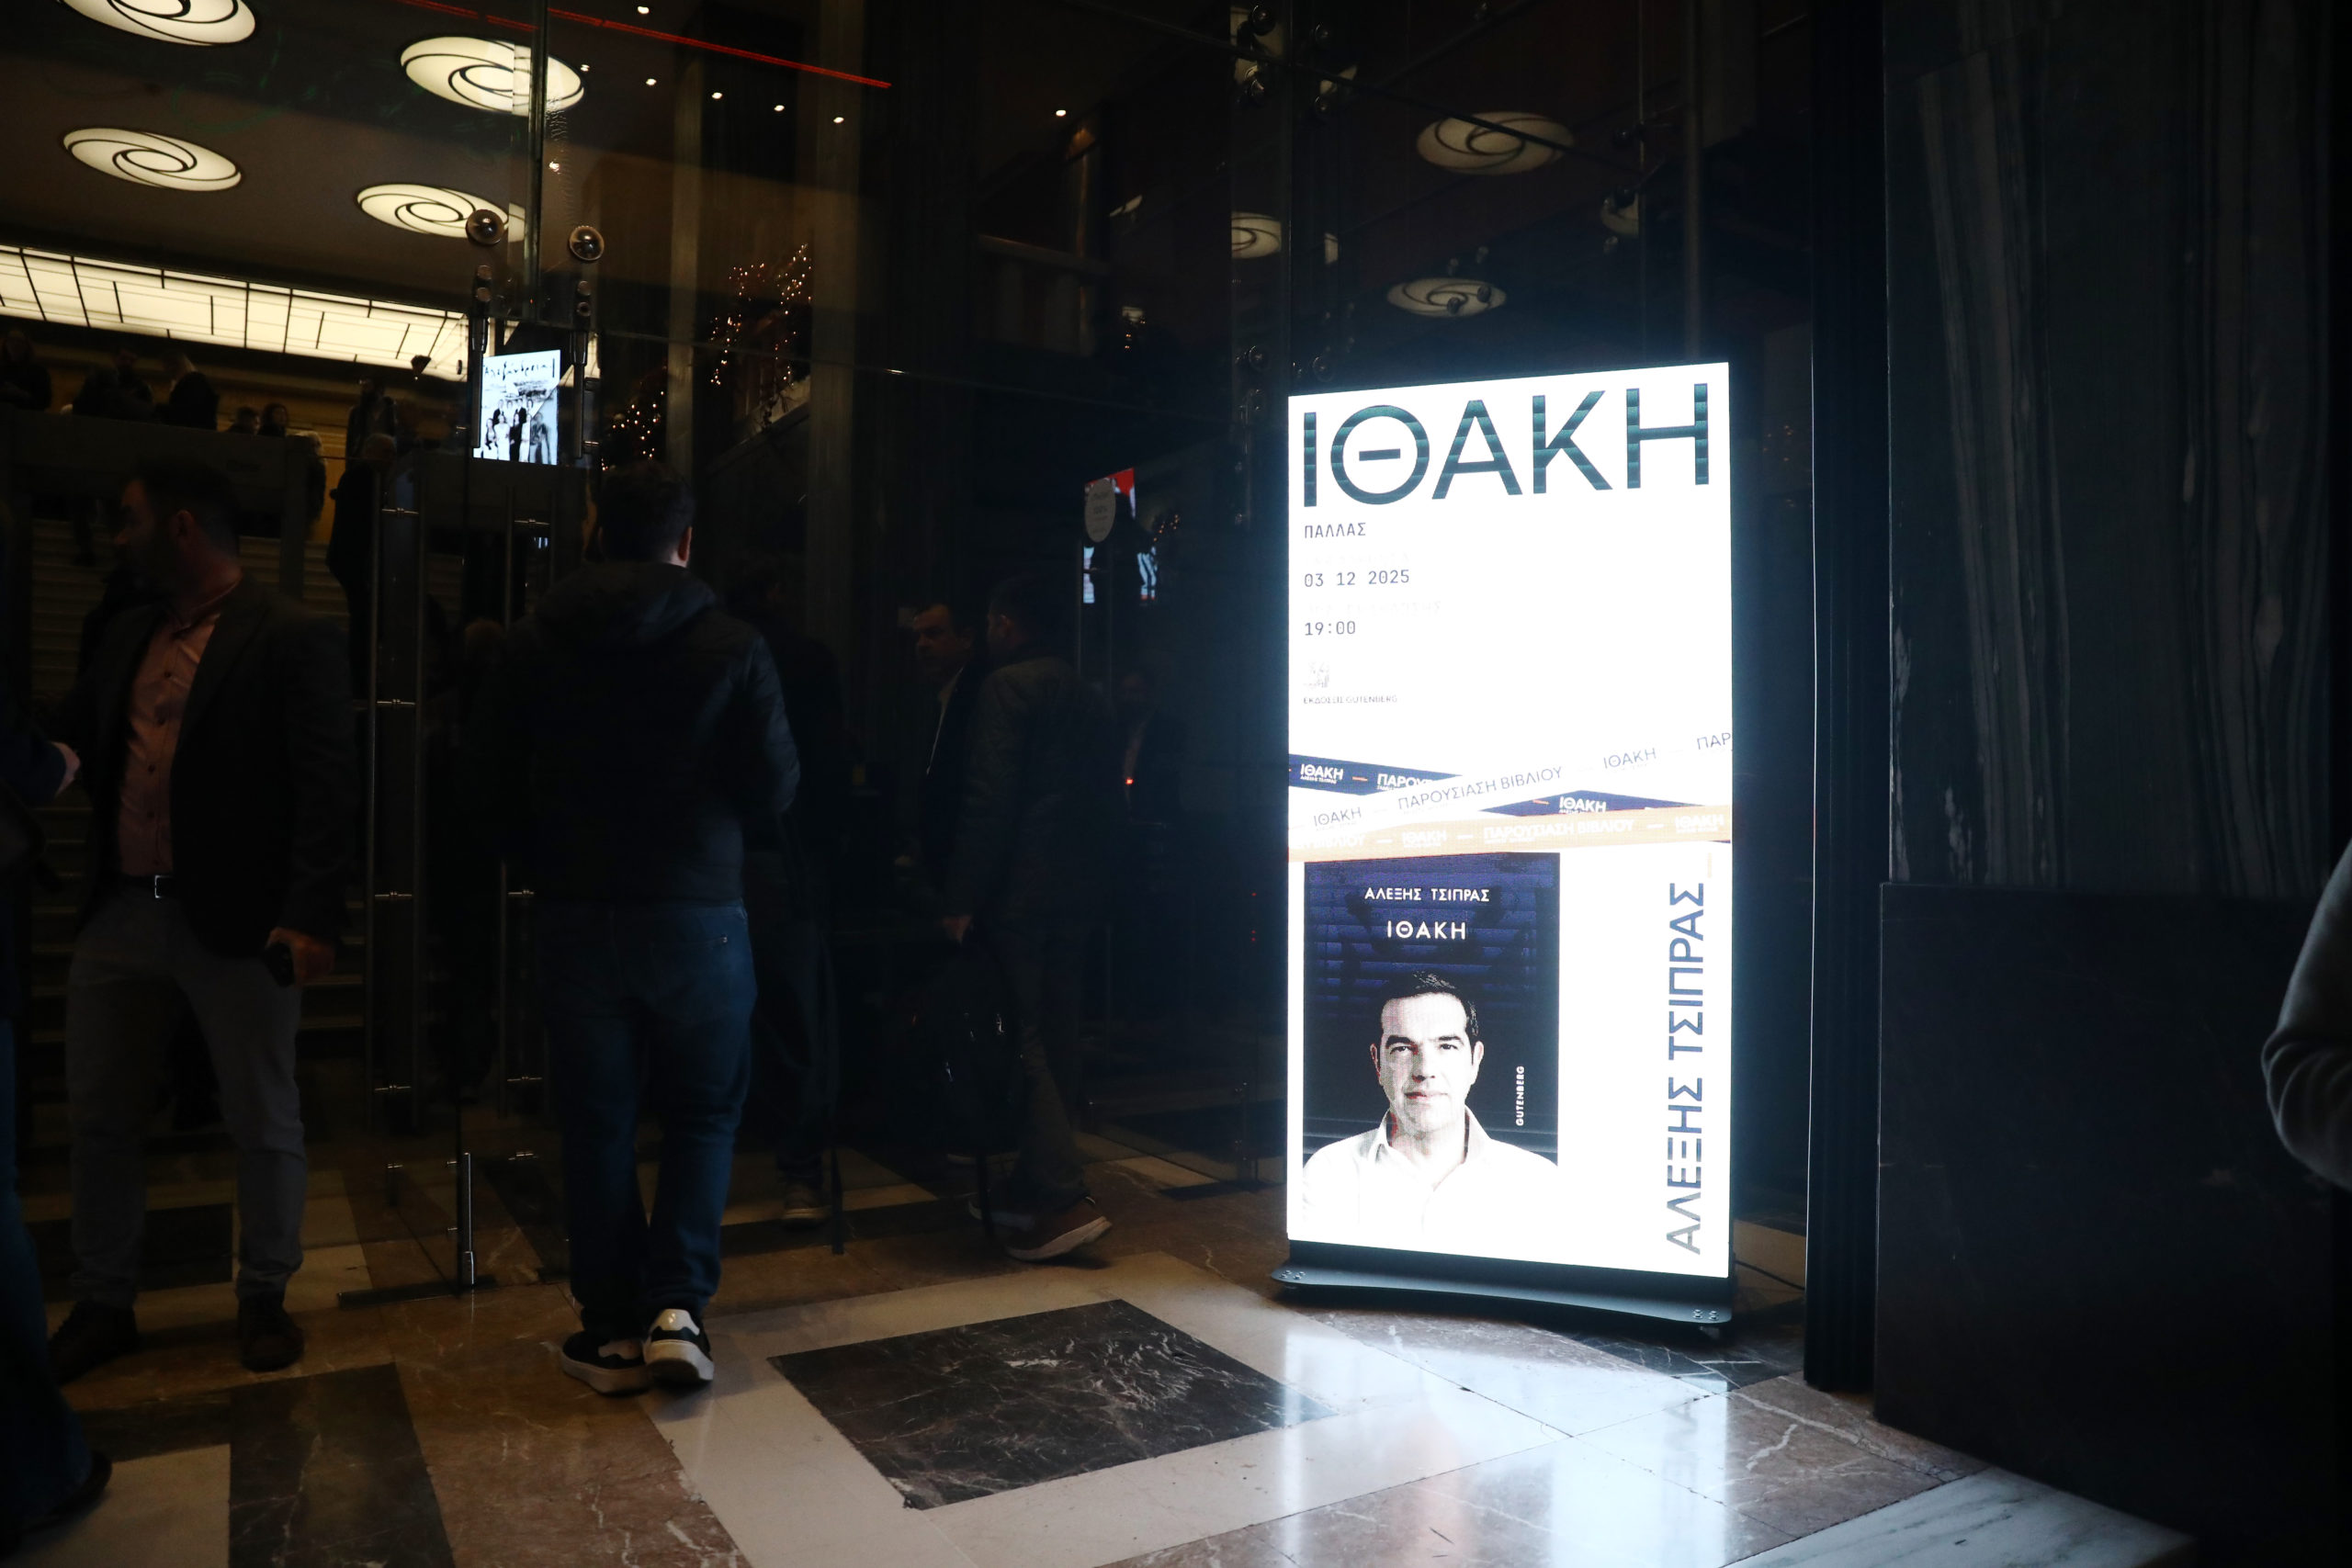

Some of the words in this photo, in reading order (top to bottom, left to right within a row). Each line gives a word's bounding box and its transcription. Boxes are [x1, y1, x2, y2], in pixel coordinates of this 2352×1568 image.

[1304, 383, 1710, 507] ΙΘΑΚΗ
[1304, 523, 1367, 539] ΠΑΛΛΑΣ
[1304, 572, 1324, 588] 03
[1336, 571, 1356, 587] 12
[1367, 569, 1410, 585] 2025
[1304, 620, 1356, 637] 19:00
[1299, 763, 1344, 781] ΙΘΑΚΗ
[1377, 773, 1433, 789] ΠΑΡΟ
[1313, 807, 1362, 827] ΙΘΑΚΗ
[1397, 777, 1498, 812] ΠΑΡΟΥΣΙΑΣΗ
[1500, 766, 1562, 790] ΒΙΒΛΙΟΥ
[1603, 747, 1657, 770] ΙΘΑΚΗ
[1559, 795, 1607, 813] ΙΘΑΚΗ
[1364, 887, 1422, 901] ΑΛΕΞΗΣ
[1430, 888, 1490, 902] ΤΣΙΠΡΑΣ
[1387, 920, 1466, 940] ΙΘΑΚΗ
[1668, 882, 1705, 1062] ΤΣΙΠΡΑΣ
[1515, 1066, 1525, 1126] GUTENBERG
[1666, 1077, 1703, 1256] ΑΛΕΞΗΣ
